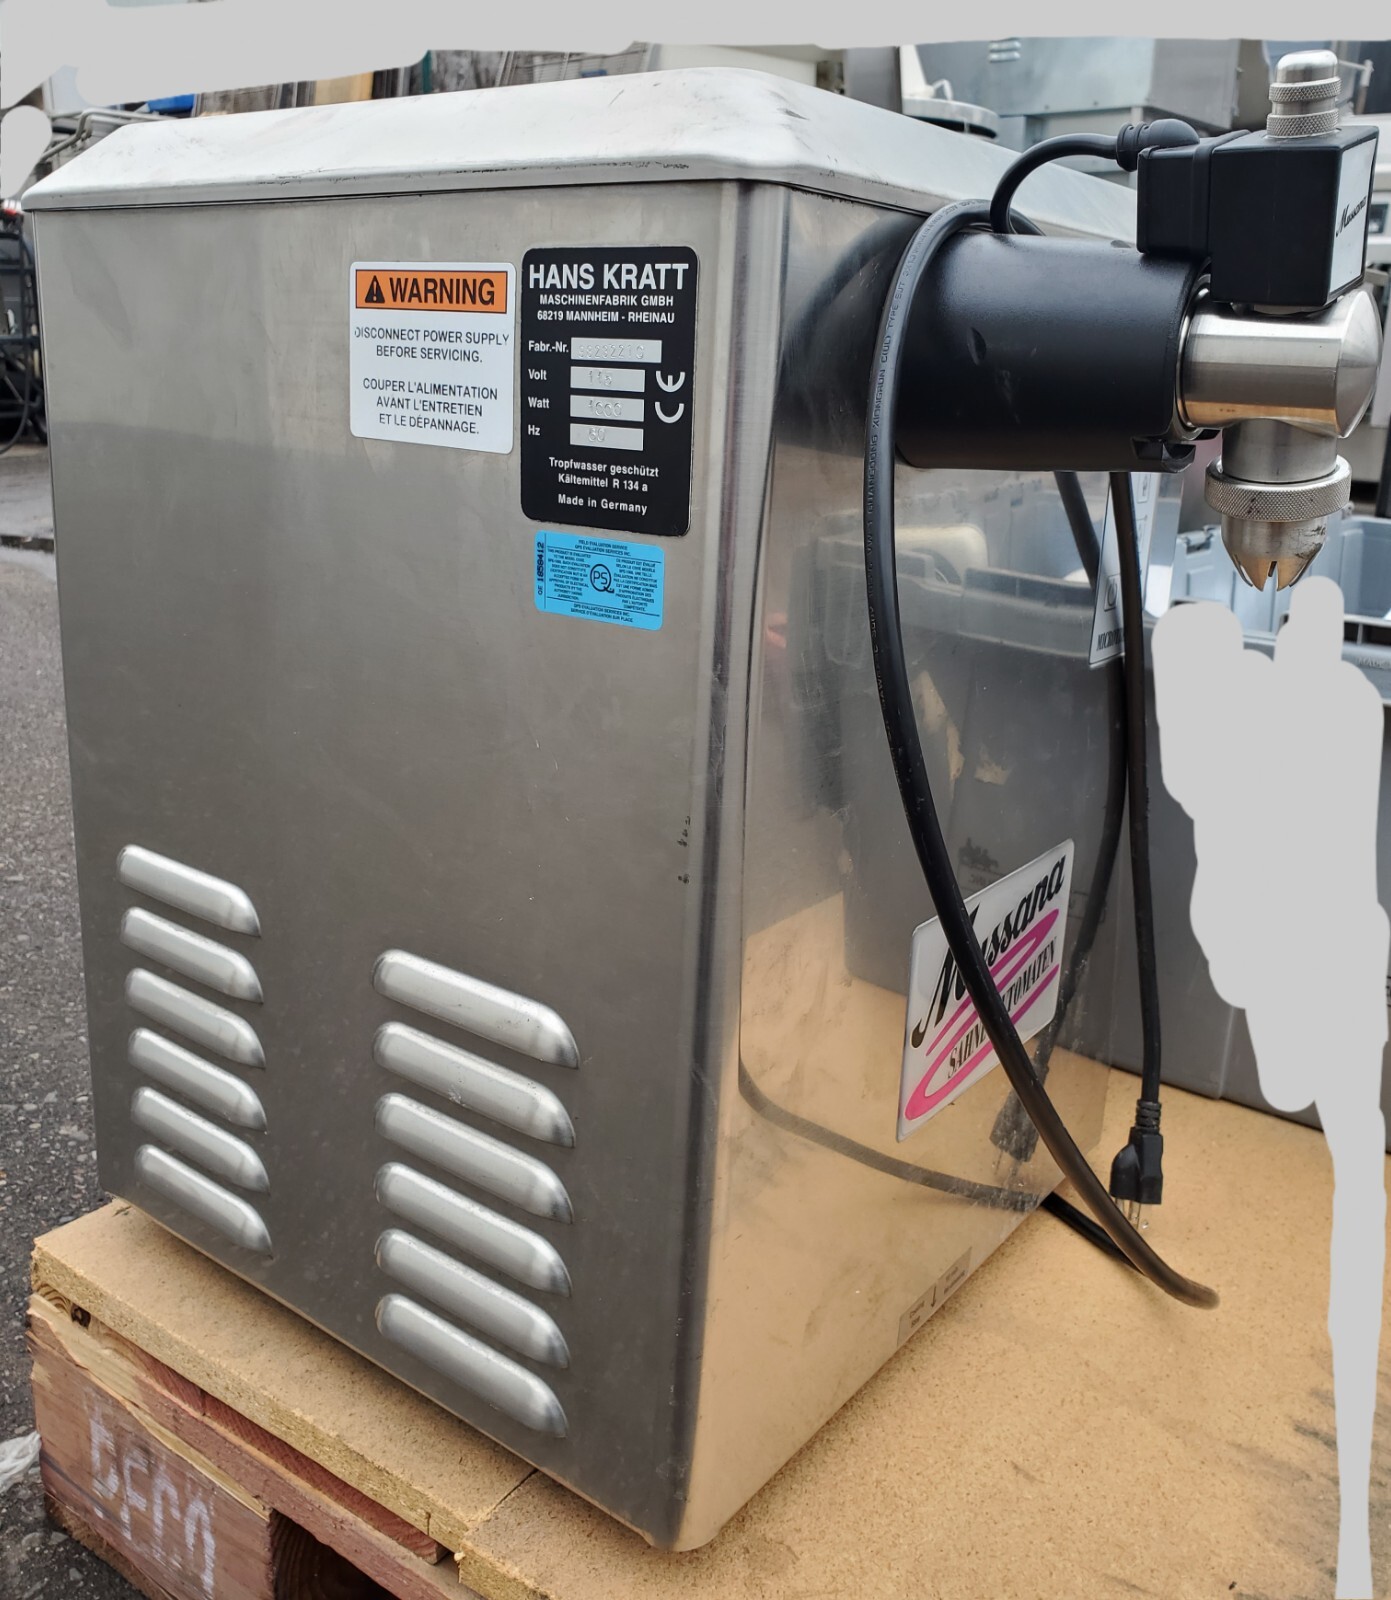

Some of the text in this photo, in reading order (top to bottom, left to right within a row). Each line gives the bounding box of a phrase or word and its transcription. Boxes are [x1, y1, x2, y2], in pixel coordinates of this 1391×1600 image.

[529, 263, 689, 290] HANS KRATT
[389, 277, 495, 306] WARNING
[540, 294, 674, 306] MASCHINENFABRIK GMBH
[537, 310, 563, 321] 68219
[566, 310, 618, 322] MANNHEIM
[628, 312, 675, 323] RHEINAU
[424, 330, 462, 342] POWER
[465, 332, 510, 346] SUPPLY
[528, 340, 569, 352] Fabr.-Nr.
[376, 345, 482, 363] BEFORE SERVICING.
[528, 369, 547, 380] Volt
[363, 378, 498, 400] COUPER L'ALIMENTATION
[376, 396, 482, 416] AVANT L'ENTRETIEN
[528, 397, 550, 409] Watt
[379, 413, 480, 434] ET LE DÉPANNAGE.
[528, 424, 540, 436] Hz
[549, 457, 659, 477] Tropfwasser geschützt
[558, 473, 648, 492] Kältemittel R 134 a
[558, 494, 648, 516] Made in Germany
